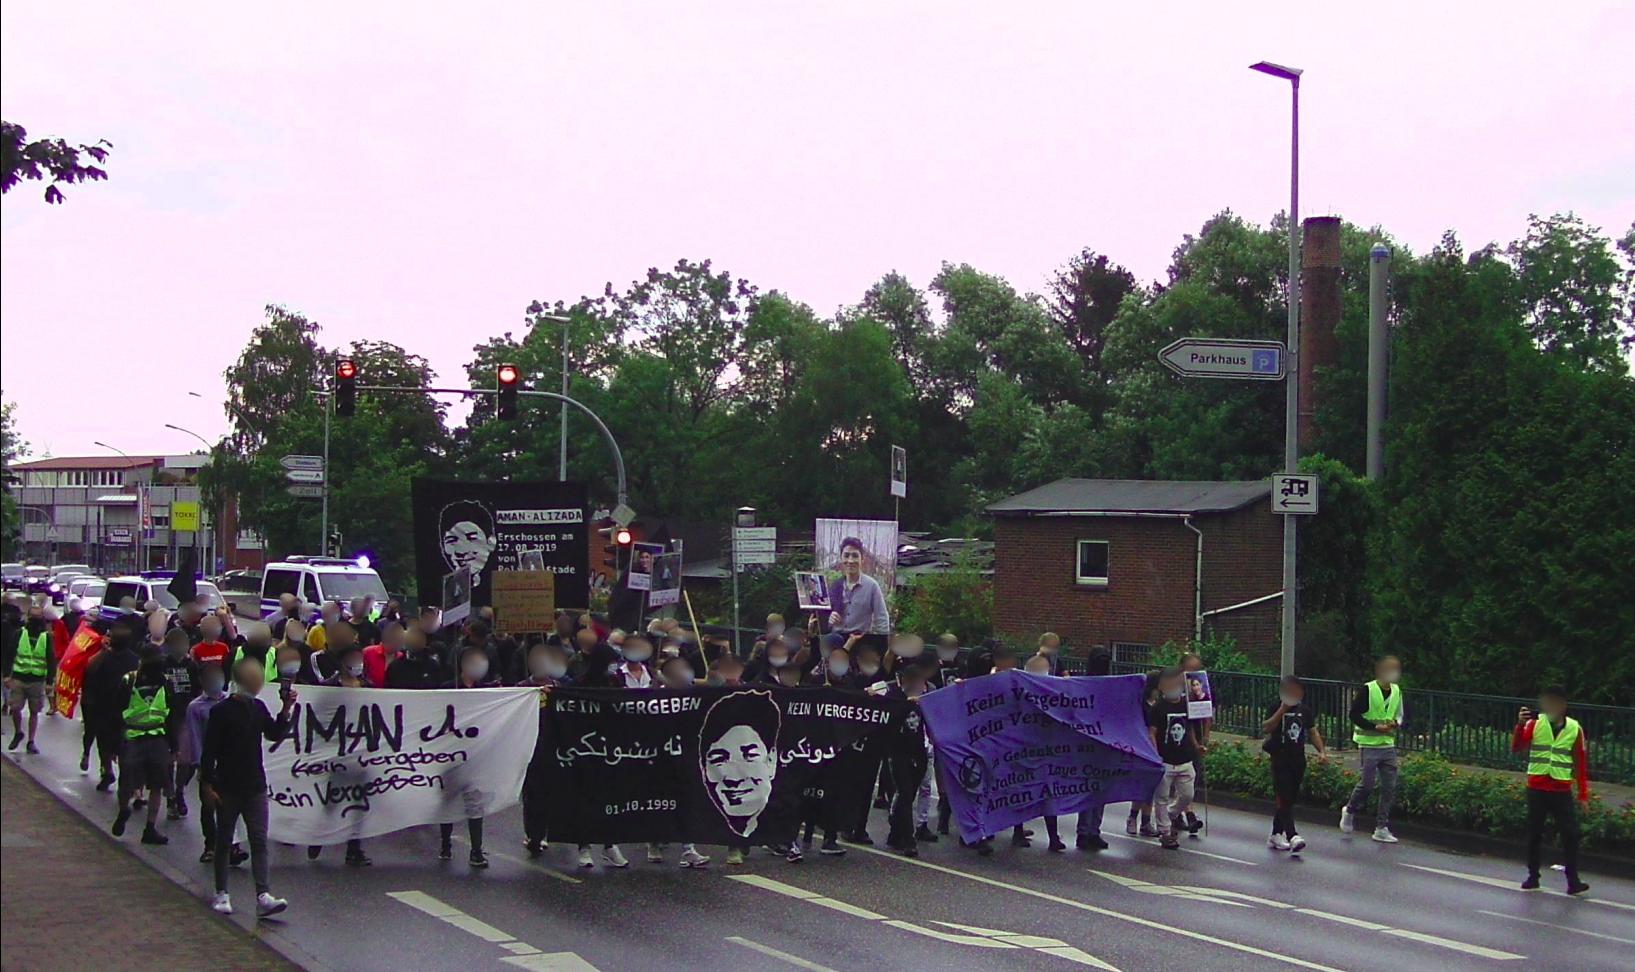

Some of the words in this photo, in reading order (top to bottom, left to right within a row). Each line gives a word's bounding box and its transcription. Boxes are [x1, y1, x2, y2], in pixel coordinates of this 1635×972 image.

[1190, 353, 1246, 365] Parkhaus
[497, 532, 556, 541] Erschossen
[561, 533, 574, 541] am
[497, 543, 557, 551] 17.082019
[546, 565, 576, 574] Stade
[555, 699, 601, 714] KEIN
[612, 697, 702, 714] VERGEBEN
[965, 693, 1005, 716] Kein
[1011, 687, 1095, 711] Vergeben!
[787, 702, 811, 716] KEIN
[816, 703, 890, 724] VERGESSEN
[268, 703, 403, 756] AMAN
[967, 719, 1004, 745] Kein
[1003, 744, 1071, 763] Gedenken
[1077, 743, 1096, 754] an
[290, 758, 347, 778] Kein
[991, 770, 1035, 792] Jalloh
[1048, 763, 1078, 778] Laye
[605, 799, 677, 815] 01.10.1999
[986, 789, 1035, 815] Aman
[1039, 779, 1101, 801] Alizada
